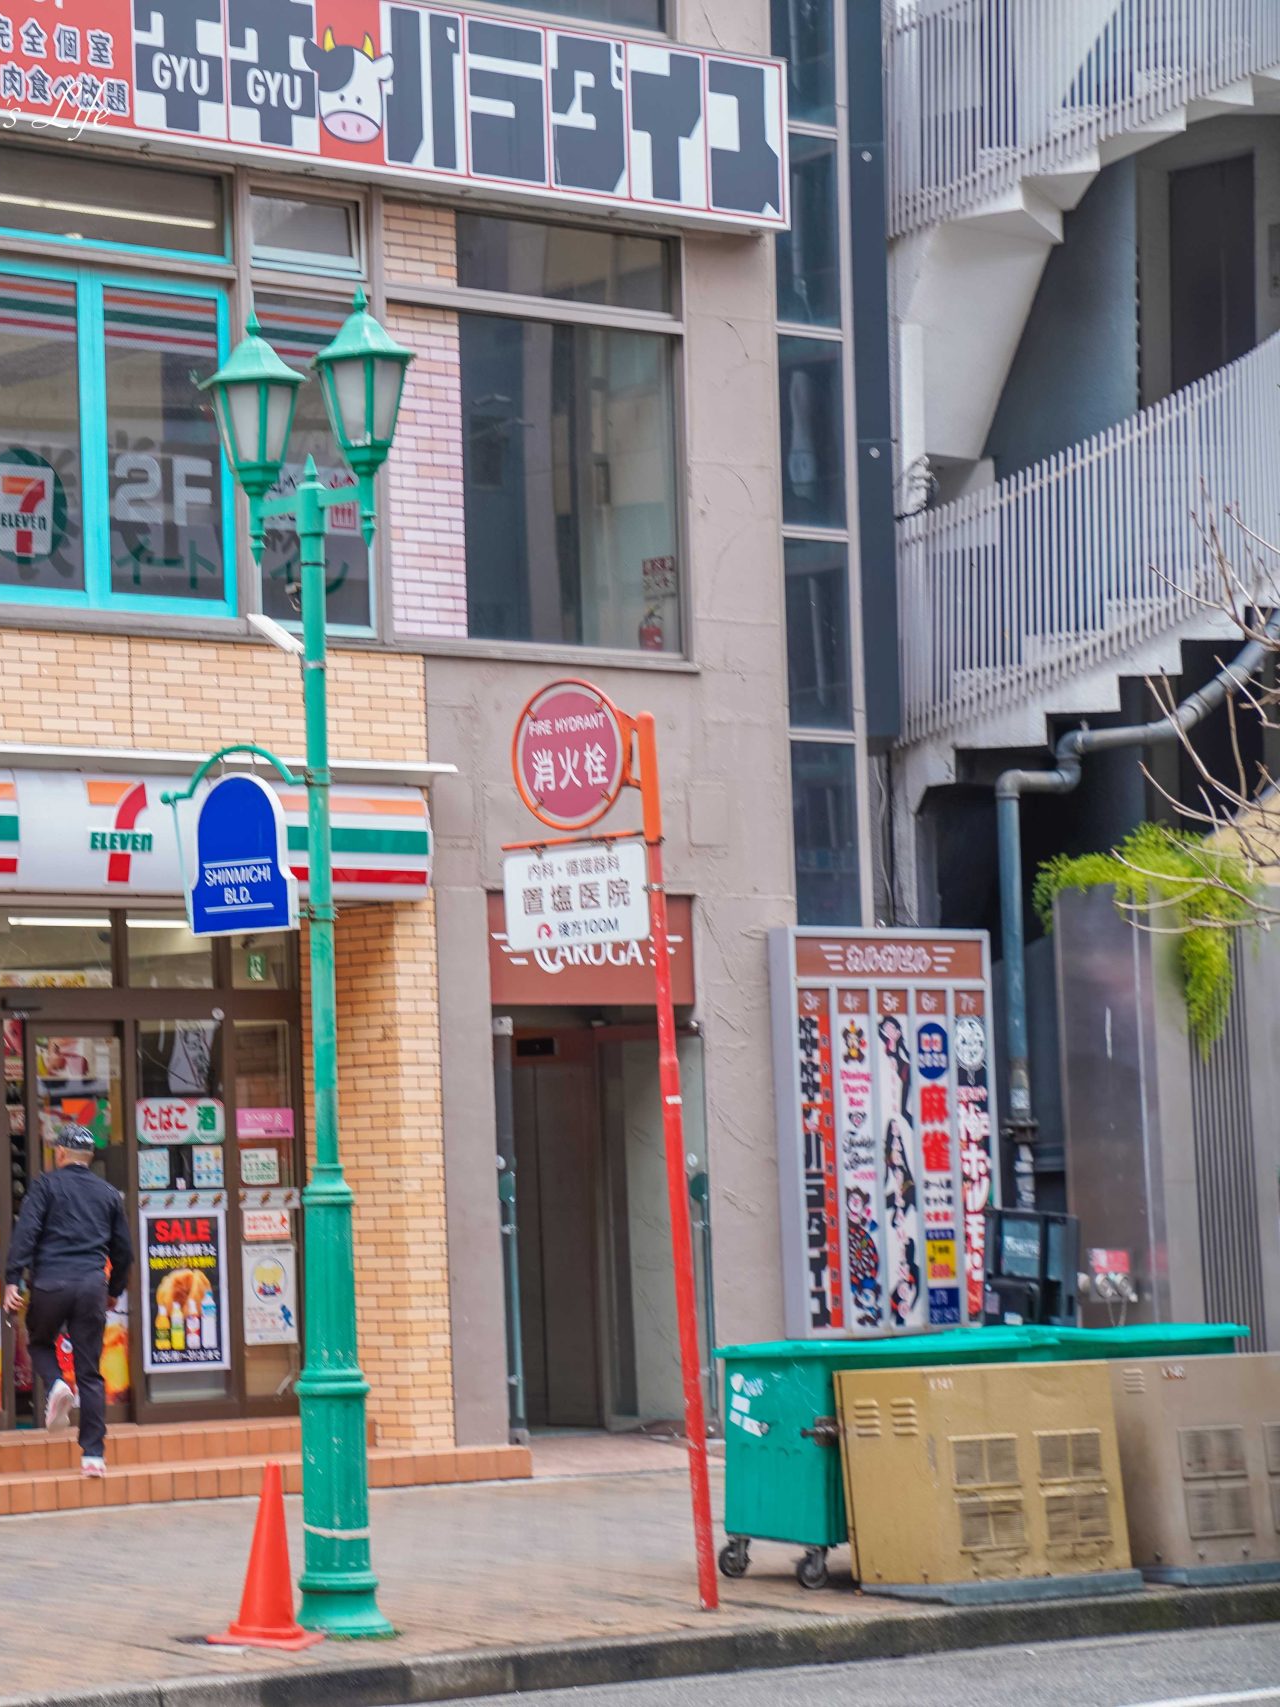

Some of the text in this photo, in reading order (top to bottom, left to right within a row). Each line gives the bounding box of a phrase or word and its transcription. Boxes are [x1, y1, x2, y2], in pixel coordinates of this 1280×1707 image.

[151, 52, 211, 96] GYU
[246, 70, 303, 111] GYU
[384, 6, 782, 216] パラダイス
[113, 452, 213, 527] 2F
[0, 512, 48, 532] ELEVEN
[528, 713, 606, 737] FIRE HYDRANT
[531, 741, 610, 793] 消火栓
[90, 831, 154, 853] ELEVEN
[204, 864, 272, 888] SHINMICHI
[224, 886, 254, 905] BLD.
[143, 1105, 189, 1131] たばこ
[197, 1105, 216, 1131] 酒
[920, 1084, 949, 1172] 麻雀
[155, 1219, 211, 1242] SALE
